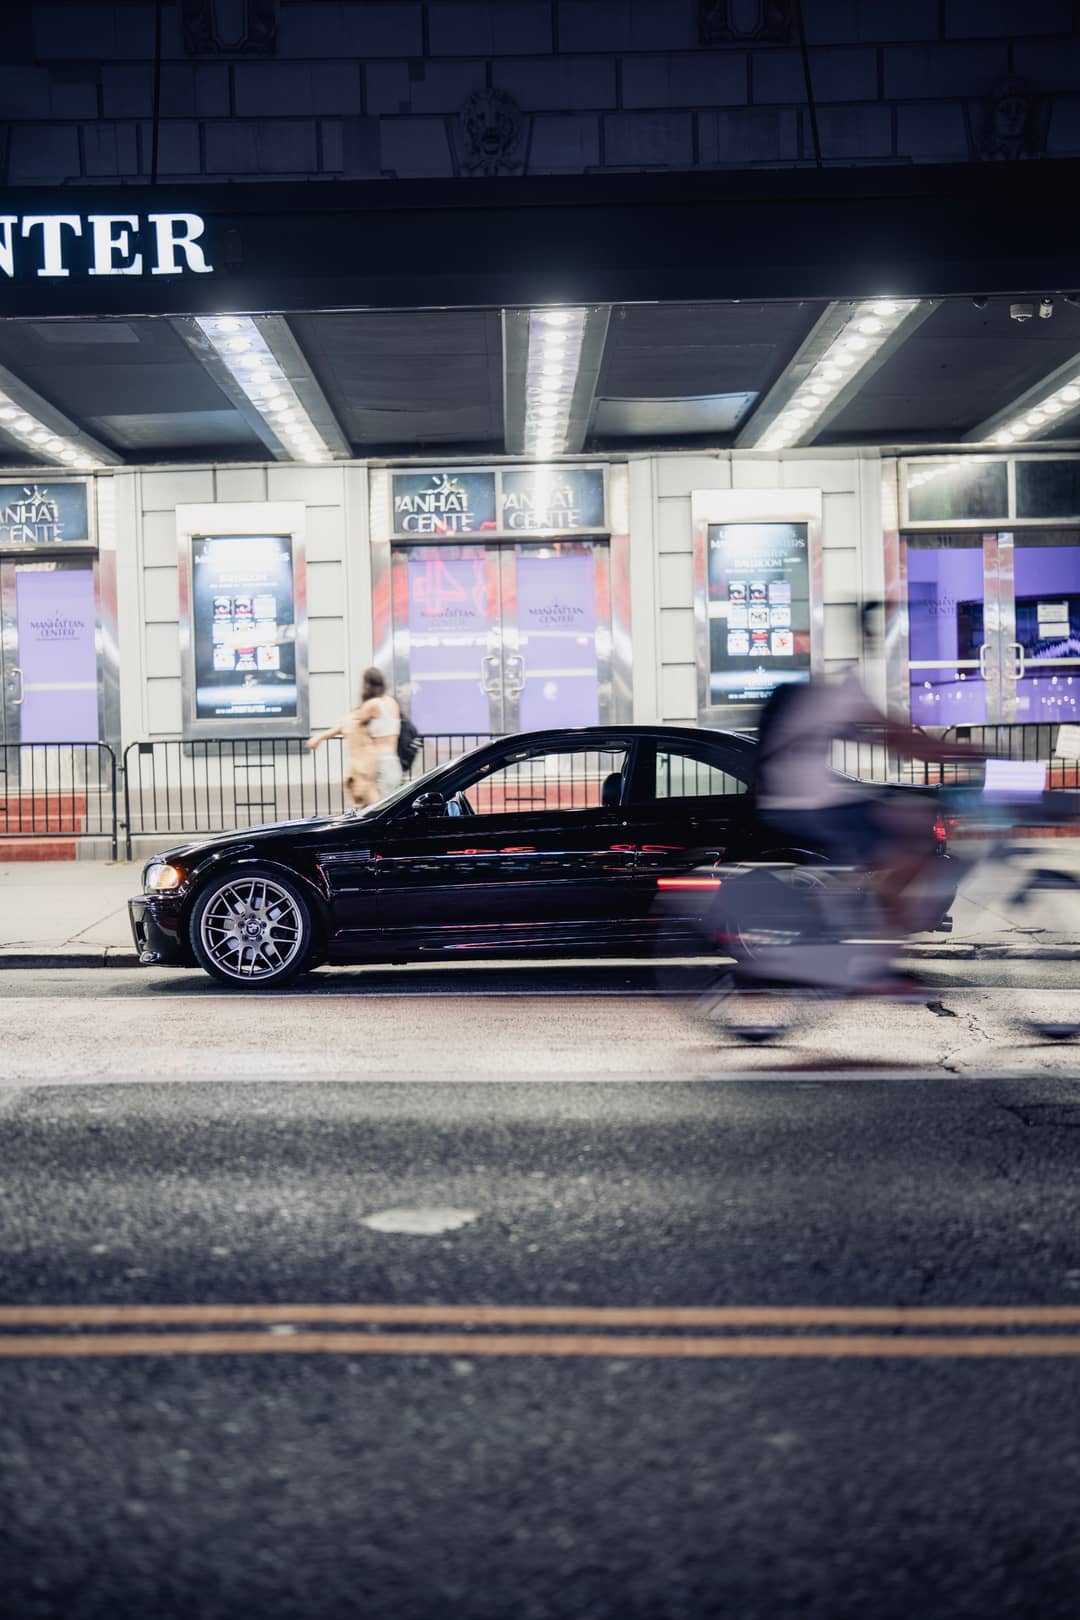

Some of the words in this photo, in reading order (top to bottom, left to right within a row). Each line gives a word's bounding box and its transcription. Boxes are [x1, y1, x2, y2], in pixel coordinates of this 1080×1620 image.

[0, 213, 214, 277] TER
[529, 607, 584, 616] MANHATTAN
[30, 621, 85, 629] MANHATTAN
